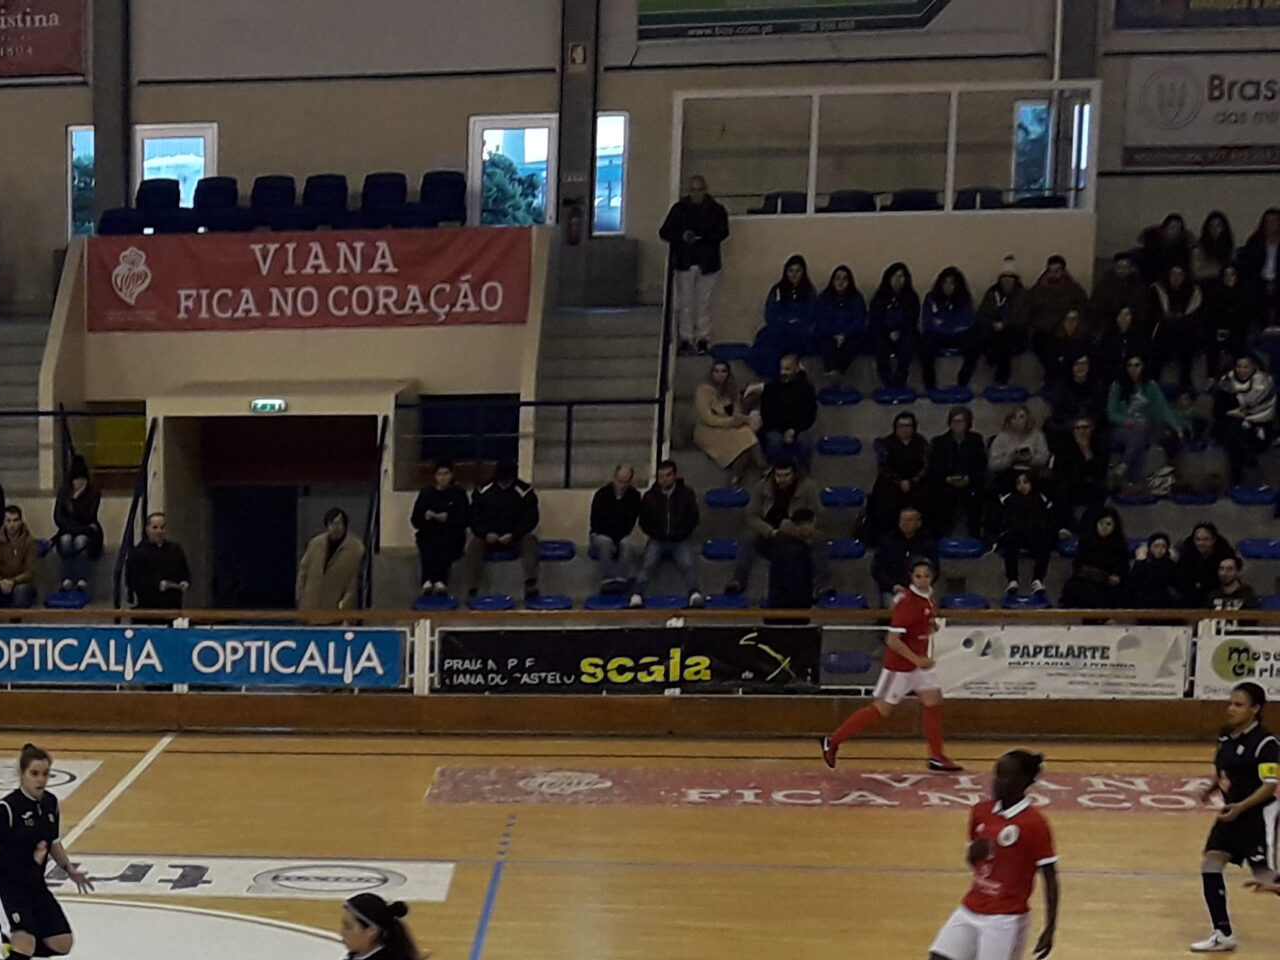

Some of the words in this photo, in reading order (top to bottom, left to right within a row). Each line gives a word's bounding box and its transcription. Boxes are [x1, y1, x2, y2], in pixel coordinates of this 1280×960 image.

[250, 241, 400, 276] VIANA
[176, 287, 261, 319] FICA
[269, 286, 320, 317] NO
[327, 274, 504, 321] CORAÇÃO
[579, 648, 712, 684] scala
[1009, 645, 1111, 660] PAPELARTE
[681, 788, 902, 806] FICA
